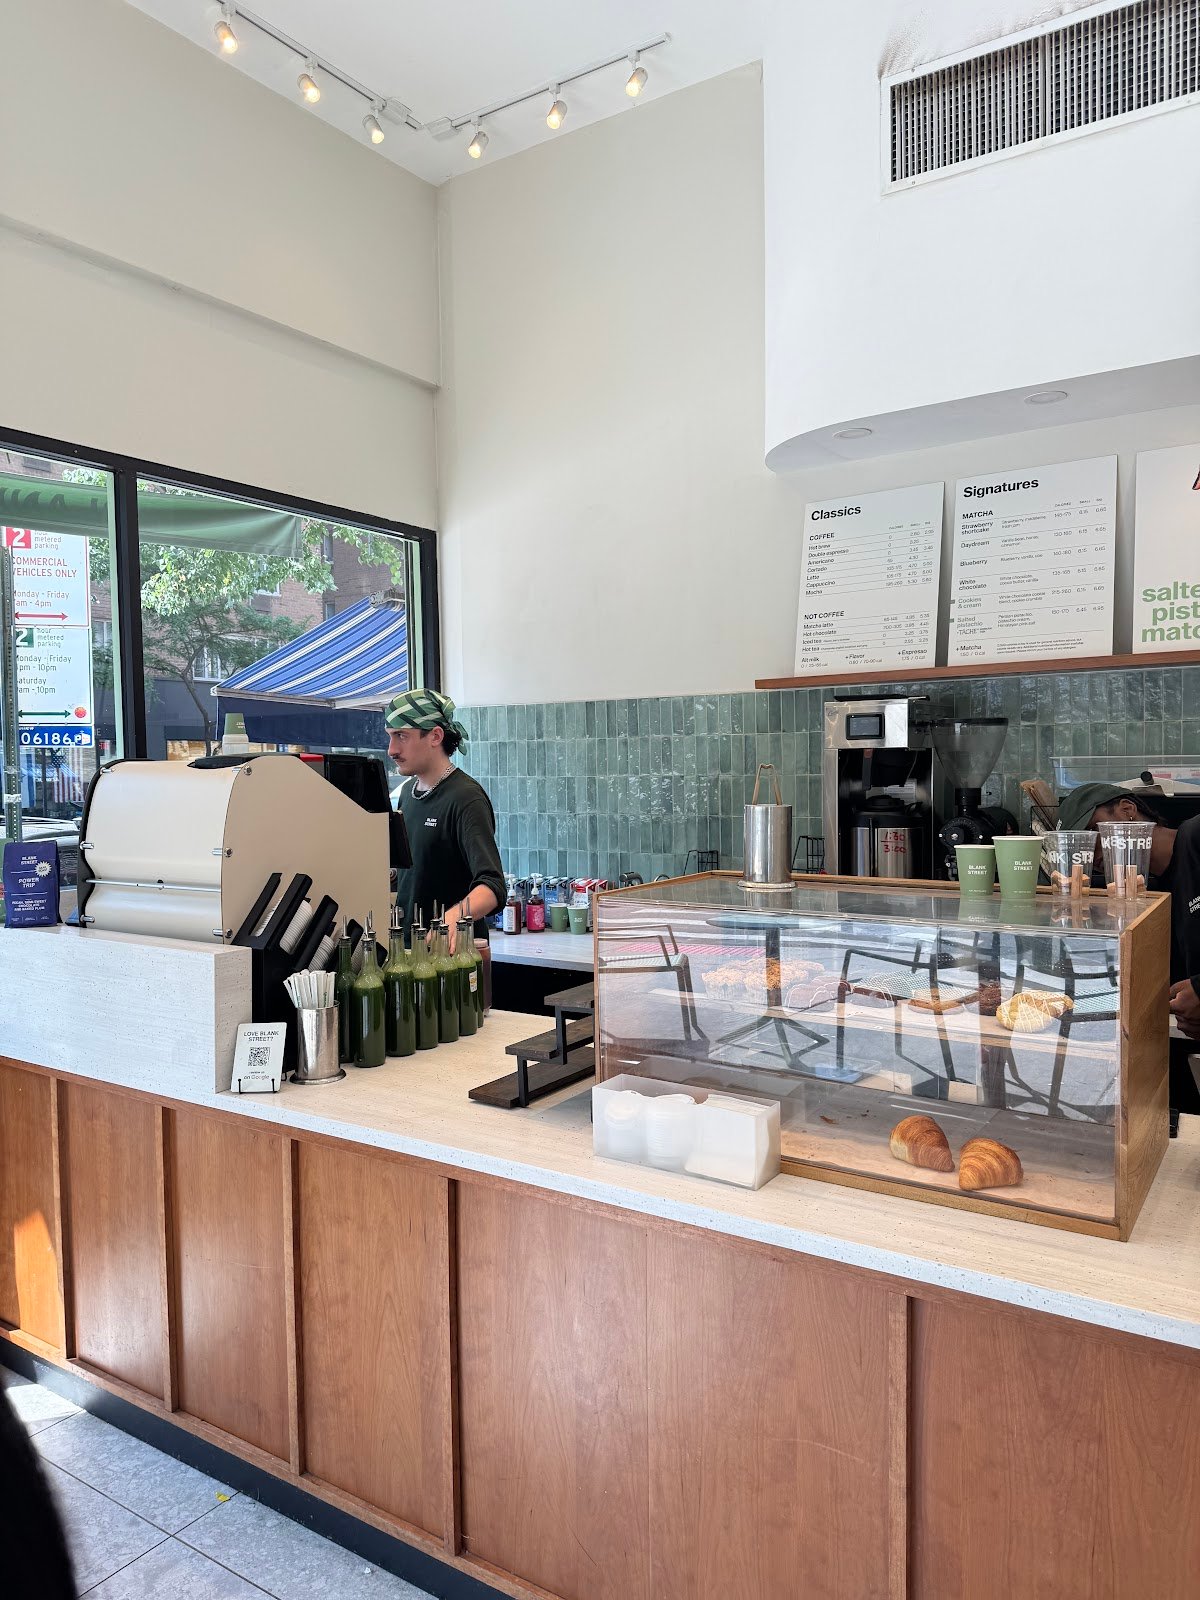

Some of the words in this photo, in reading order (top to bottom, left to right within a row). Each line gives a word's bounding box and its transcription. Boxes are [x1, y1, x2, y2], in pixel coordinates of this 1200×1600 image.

[964, 480, 1038, 498] Signatures
[812, 506, 861, 520] Classics
[962, 510, 993, 519] MATCHA
[962, 521, 993, 530] Strawberry
[12, 528, 25, 546] 2
[47, 591, 69, 599] Friday
[1142, 581, 1200, 602] salte
[16, 629, 28, 646] 2
[38, 664, 56, 672] 10pm
[17, 677, 46, 687] aturday
[37, 686, 55, 694] 10pm
[21, 733, 71, 744] 06186
